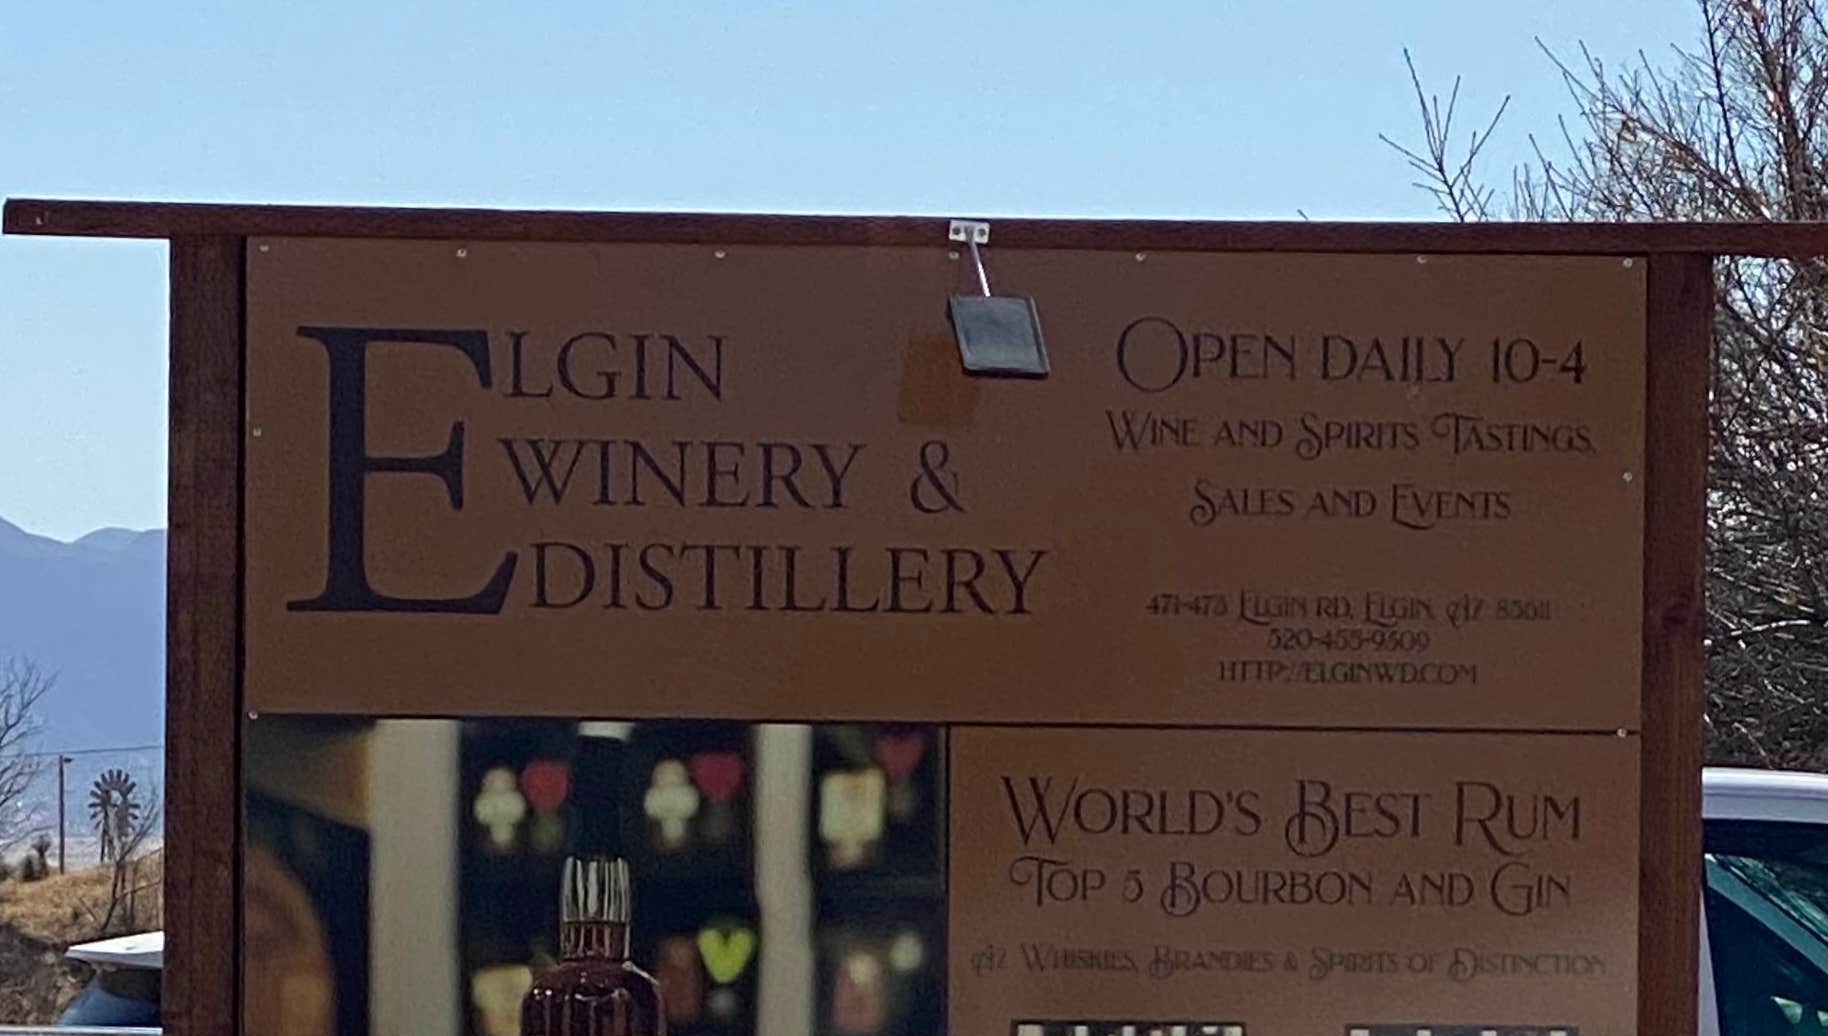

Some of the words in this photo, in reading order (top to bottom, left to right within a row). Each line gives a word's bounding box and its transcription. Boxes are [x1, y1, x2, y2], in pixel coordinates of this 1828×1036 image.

[1117, 317, 1296, 393] OPEN
[1322, 335, 1464, 383] DAILY
[1492, 336, 1587, 384] 10-4
[287, 325, 726, 613] ELGIN
[1105, 410, 1200, 450] WINE
[1213, 420, 1283, 448] AND
[1296, 412, 1420, 460] SPIRITS
[500, 438, 866, 511] WINERY
[911, 440, 967, 514] &
[1190, 479, 1296, 526] SALES
[1309, 489, 1377, 518] AND
[1392, 483, 1511, 530] EVENTS
[530, 540, 1048, 614] DISTILLERY
[1001, 776, 1262, 846] WORLD'S
[1285, 779, 1431, 857] BEST
[1456, 780, 1580, 857] RUM
[1009, 856, 1105, 907] TOP
[1161, 862, 1372, 918] BOURBON
[1393, 872, 1474, 907] AND
[1491, 861, 1571, 916] GIN
[1283, 951, 1298, 972] &
[1407, 952, 1440, 974] OF
